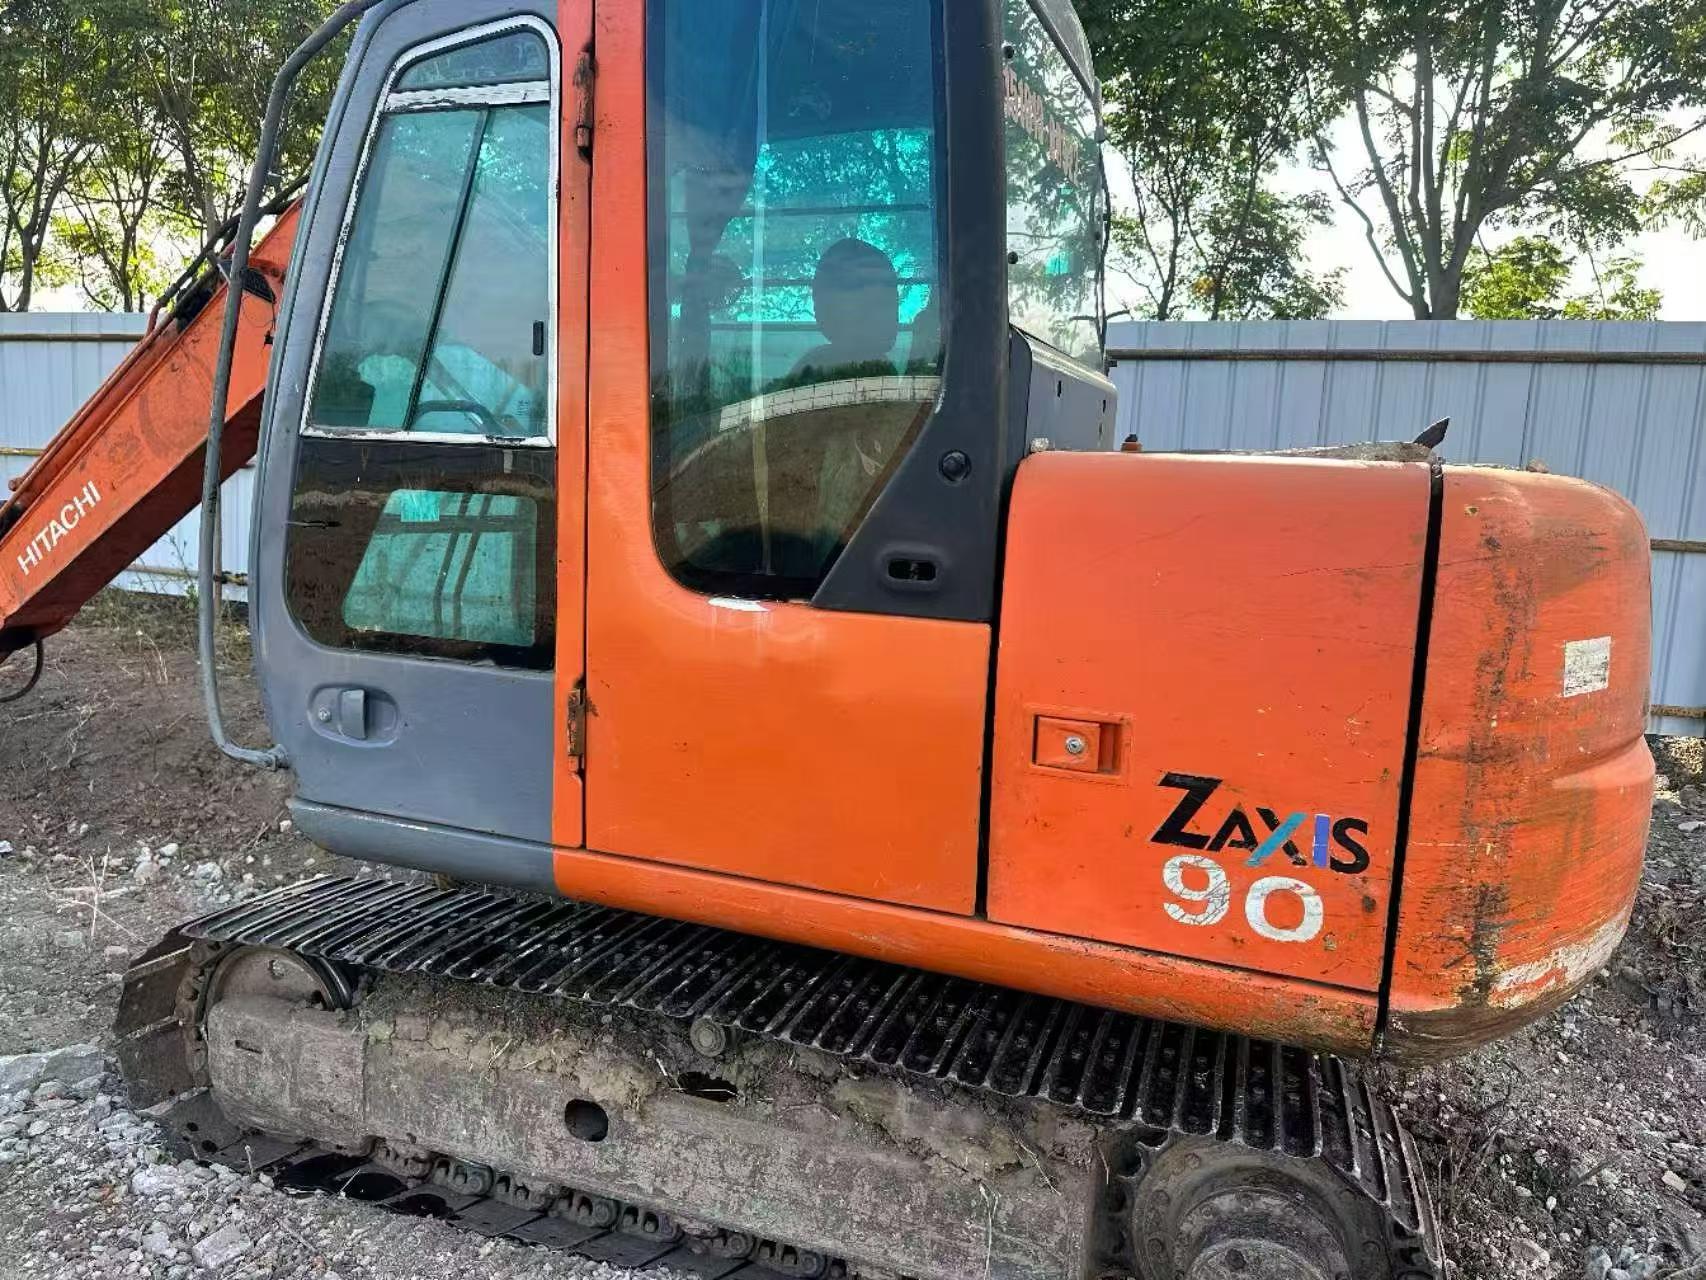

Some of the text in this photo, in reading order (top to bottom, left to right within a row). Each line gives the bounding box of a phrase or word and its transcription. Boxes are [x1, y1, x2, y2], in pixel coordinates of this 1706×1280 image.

[17, 480, 101, 576] HITACHI
[1151, 772, 1370, 874] ZAXIS
[1162, 855, 1324, 943] 90
